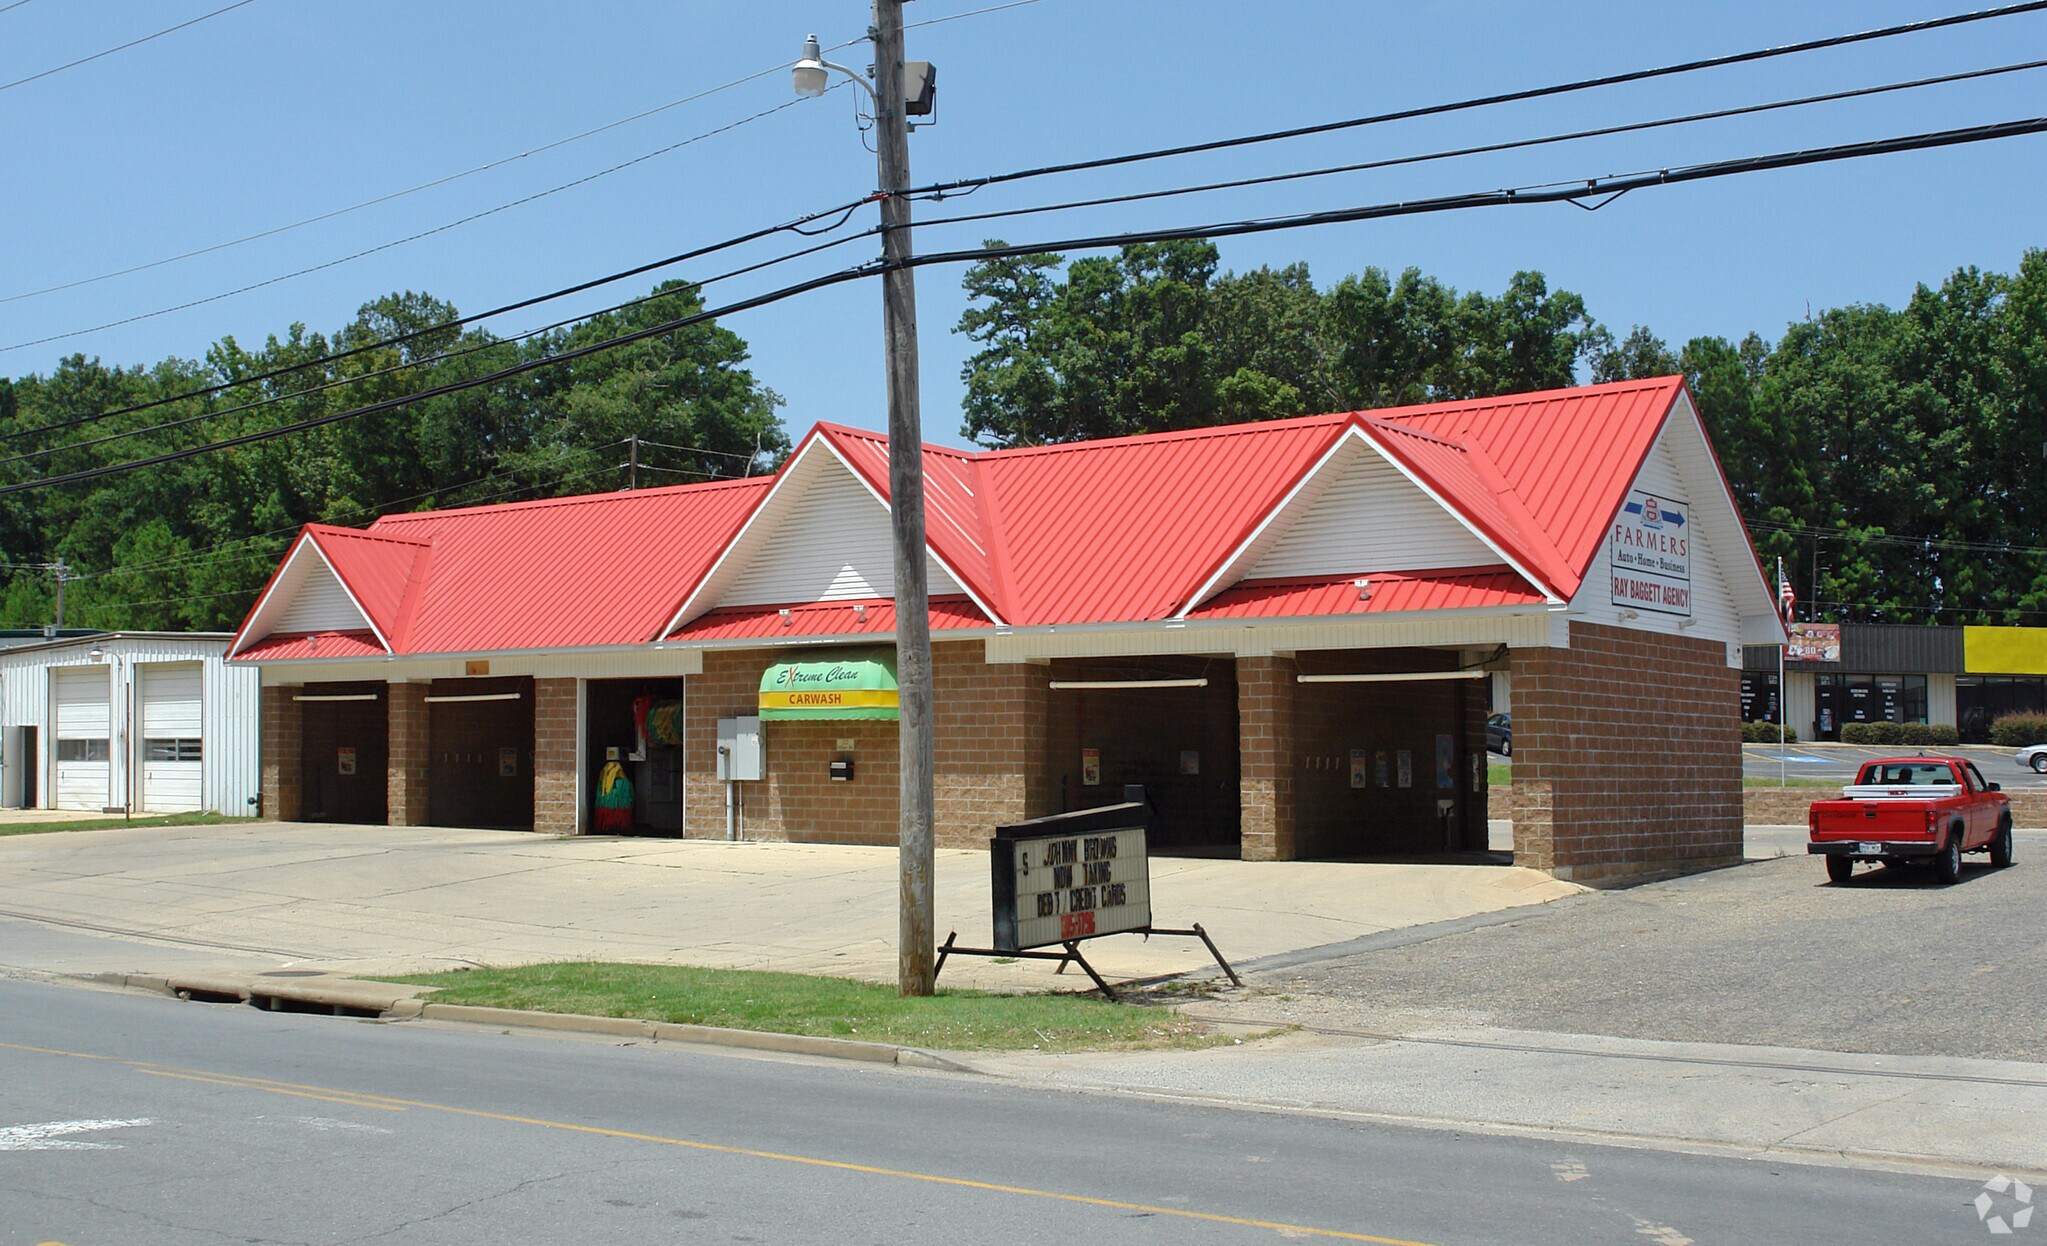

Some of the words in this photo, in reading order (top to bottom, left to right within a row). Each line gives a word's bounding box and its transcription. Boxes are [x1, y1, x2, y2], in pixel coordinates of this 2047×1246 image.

[1615, 525, 1687, 556] FARMERS
[1617, 549, 1634, 564] Auto
[1637, 553, 1656, 568] Home
[1659, 557, 1685, 574] Business
[1614, 576, 1628, 597] RAY
[1630, 581, 1661, 603] BAGGETT
[1663, 585, 1688, 608] AGENCY
[825, 666, 858, 683] Clean
[789, 693, 841, 704] CARWASH
[1053, 865, 1073, 889] NOW
[1083, 861, 1111, 885] TAKING
[1070, 887, 1097, 912] CREDIT
[1101, 883, 1126, 908] CARDS
